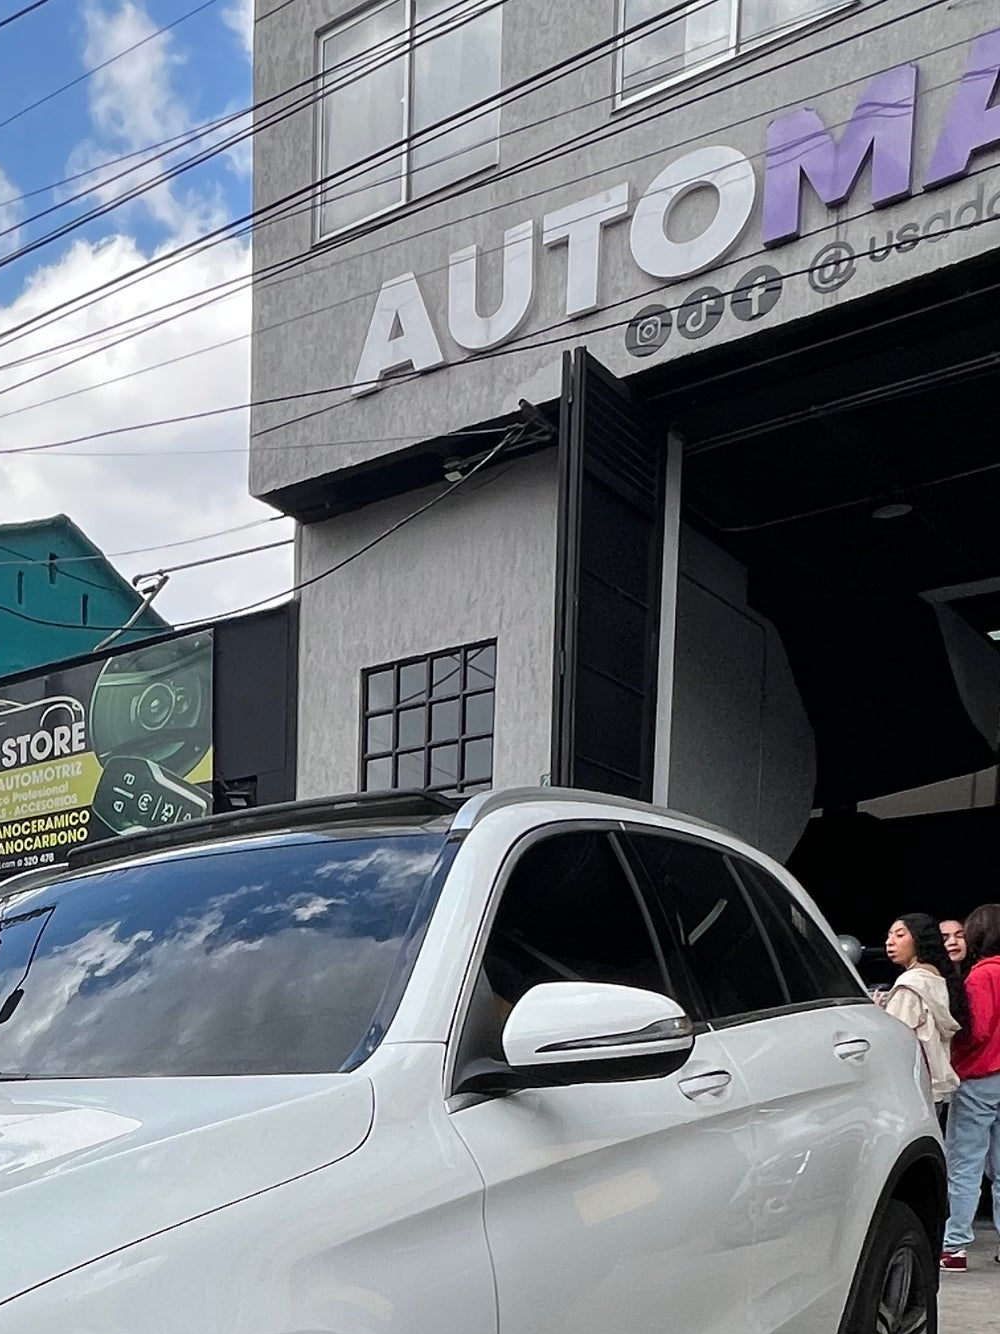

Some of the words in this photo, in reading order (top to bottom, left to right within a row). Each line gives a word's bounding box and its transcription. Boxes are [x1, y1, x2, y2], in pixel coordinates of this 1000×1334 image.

[1, 721, 86, 768] STORE
[12, 782, 69, 802] Profesional
[14, 793, 78, 817] ACCESORIOS
